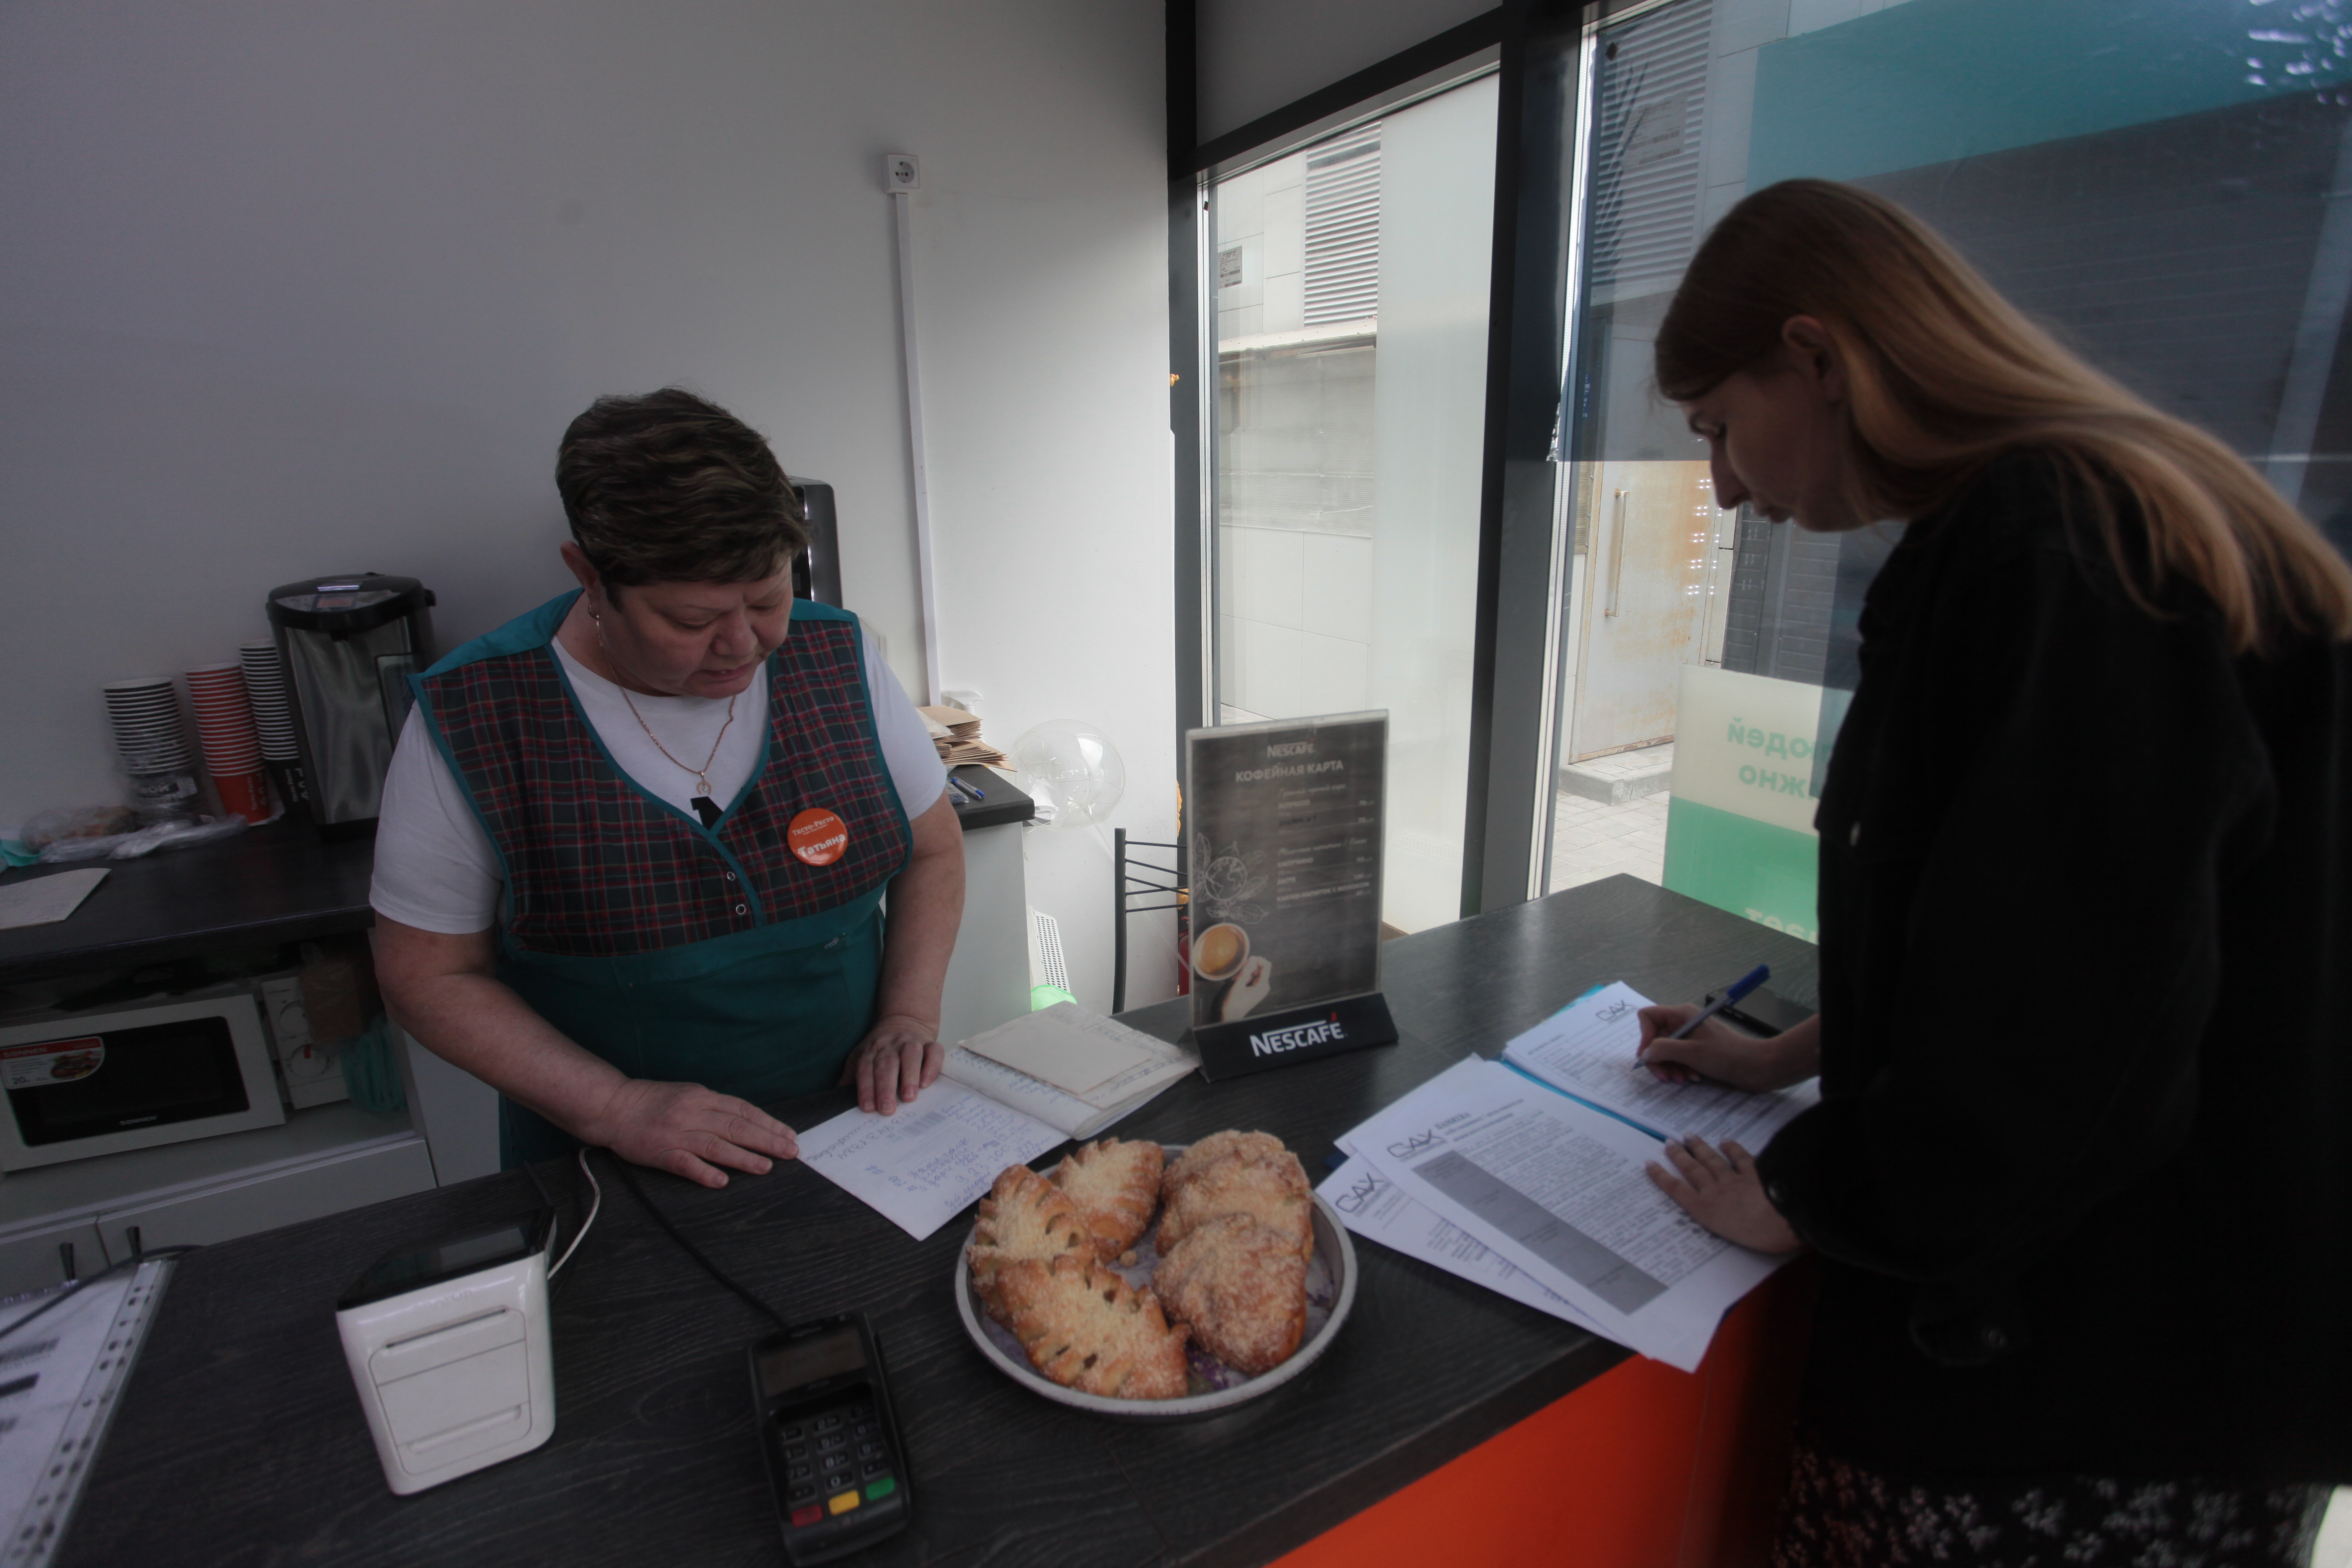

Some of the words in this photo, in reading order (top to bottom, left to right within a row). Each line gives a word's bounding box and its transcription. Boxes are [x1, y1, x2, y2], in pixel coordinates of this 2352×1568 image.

[1235, 762, 1304, 782] КОФЕЙНАЯ
[1308, 760, 1344, 774] КАРТА
[797, 834, 846, 857] Татьяна
